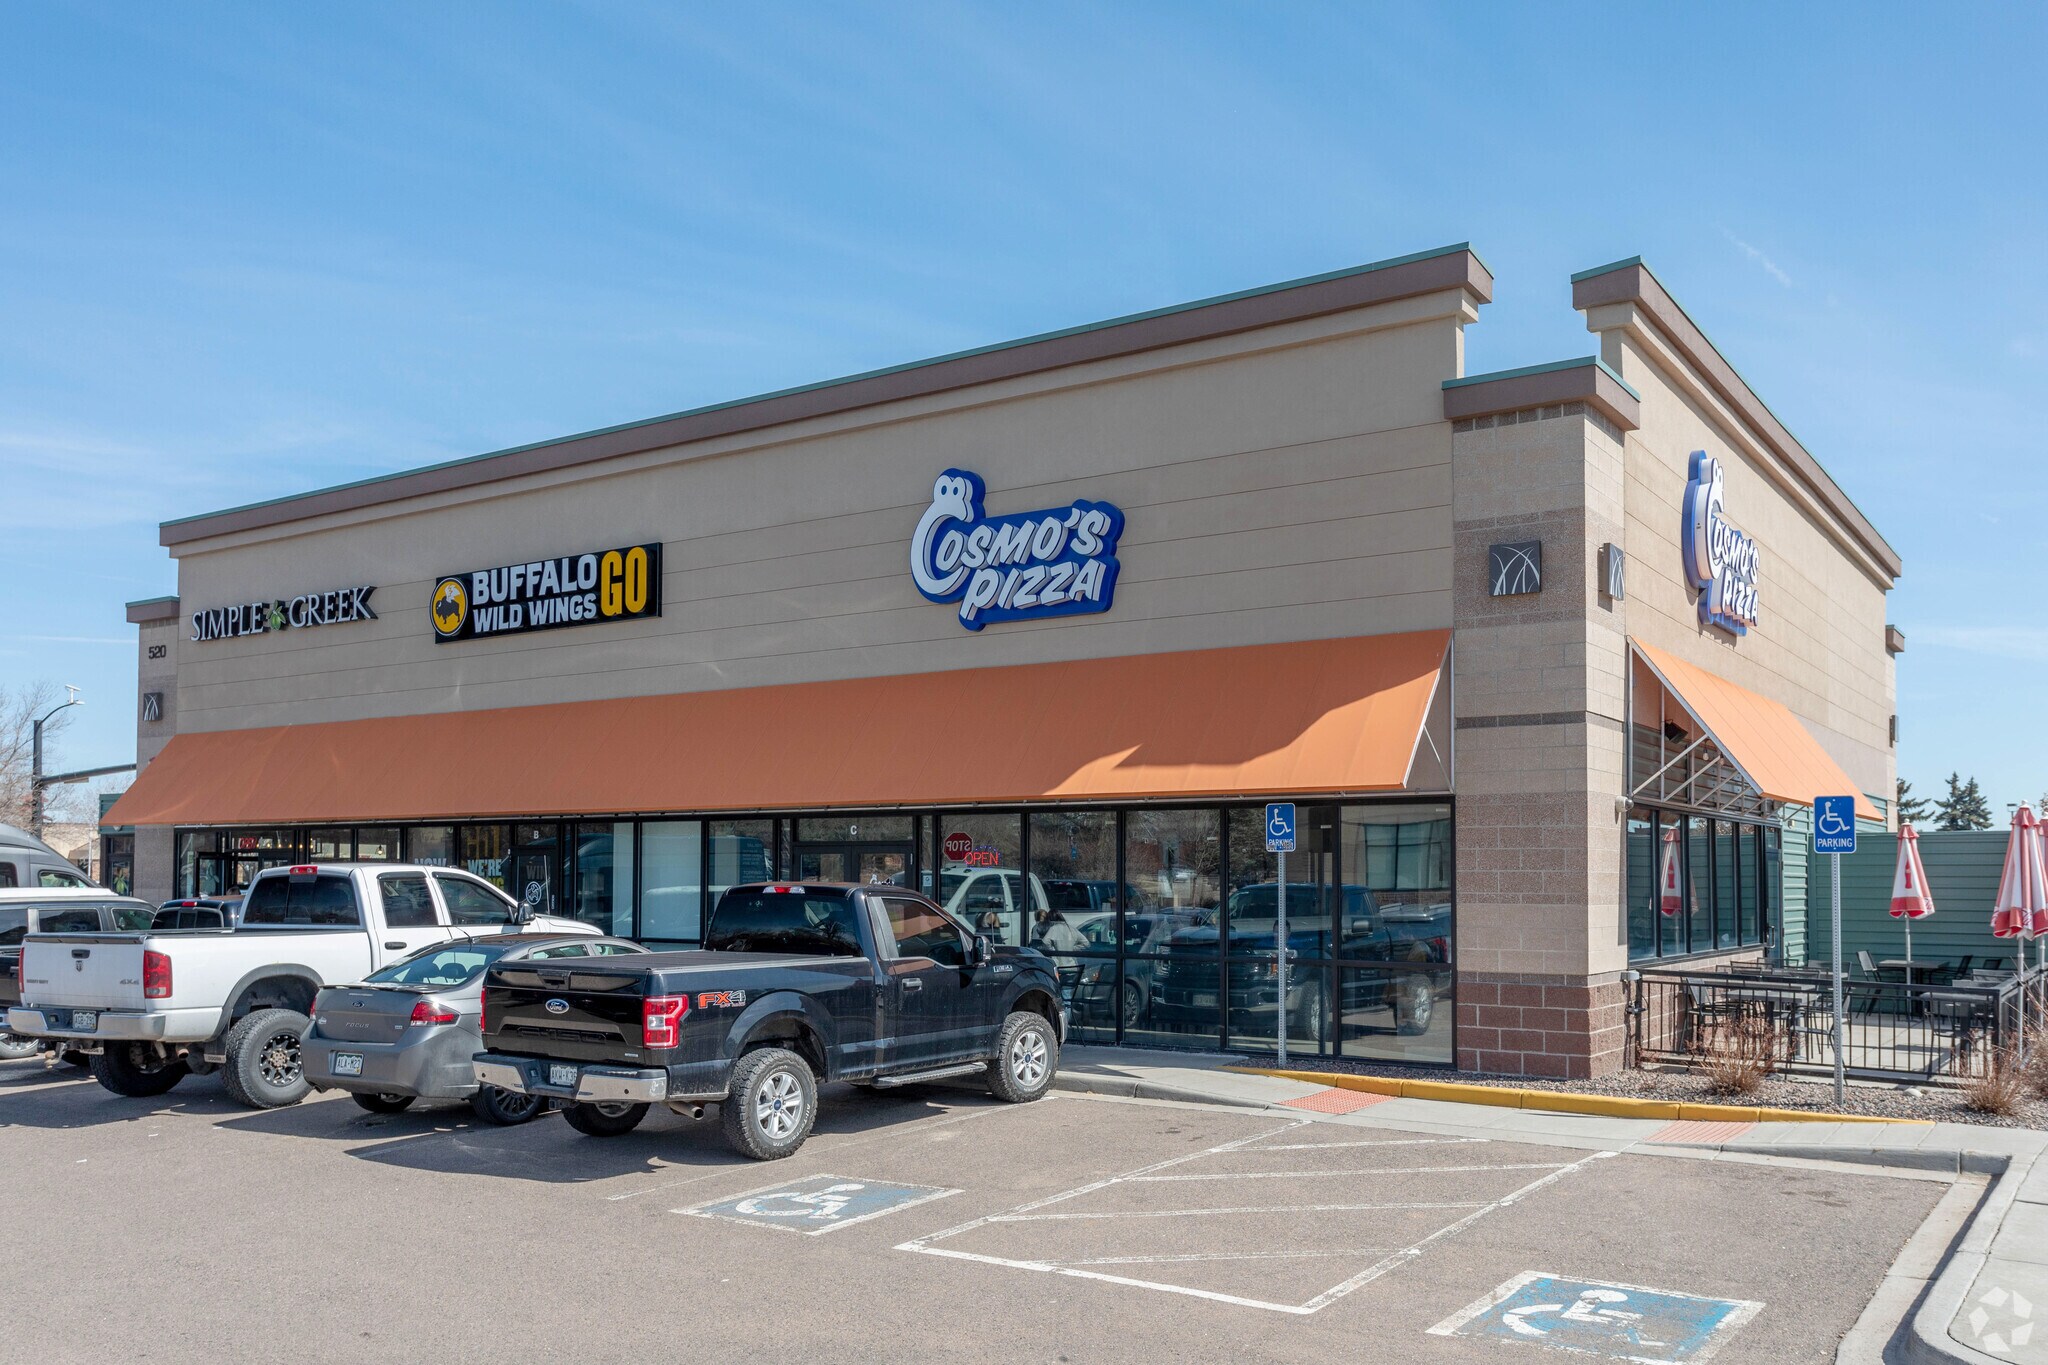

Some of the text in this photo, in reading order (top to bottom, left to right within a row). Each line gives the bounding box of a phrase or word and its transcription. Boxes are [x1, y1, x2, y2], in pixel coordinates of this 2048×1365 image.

[910, 474, 1111, 595] COSMO'S
[472, 554, 597, 605] BUFFALO
[601, 547, 648, 617] GO
[960, 558, 1106, 620] PIZZA
[1721, 567, 1760, 627] PIZZA
[190, 585, 376, 641] SIMPLE GREEK
[473, 595, 597, 633] WILD WINGS
[148, 645, 166, 660] 520
[533, 830, 539, 839] B
[850, 825, 857, 835] C
[1817, 838, 1853, 848] PARKING
[964, 851, 999, 866] OPEN
[698, 990, 746, 1009] FX4
